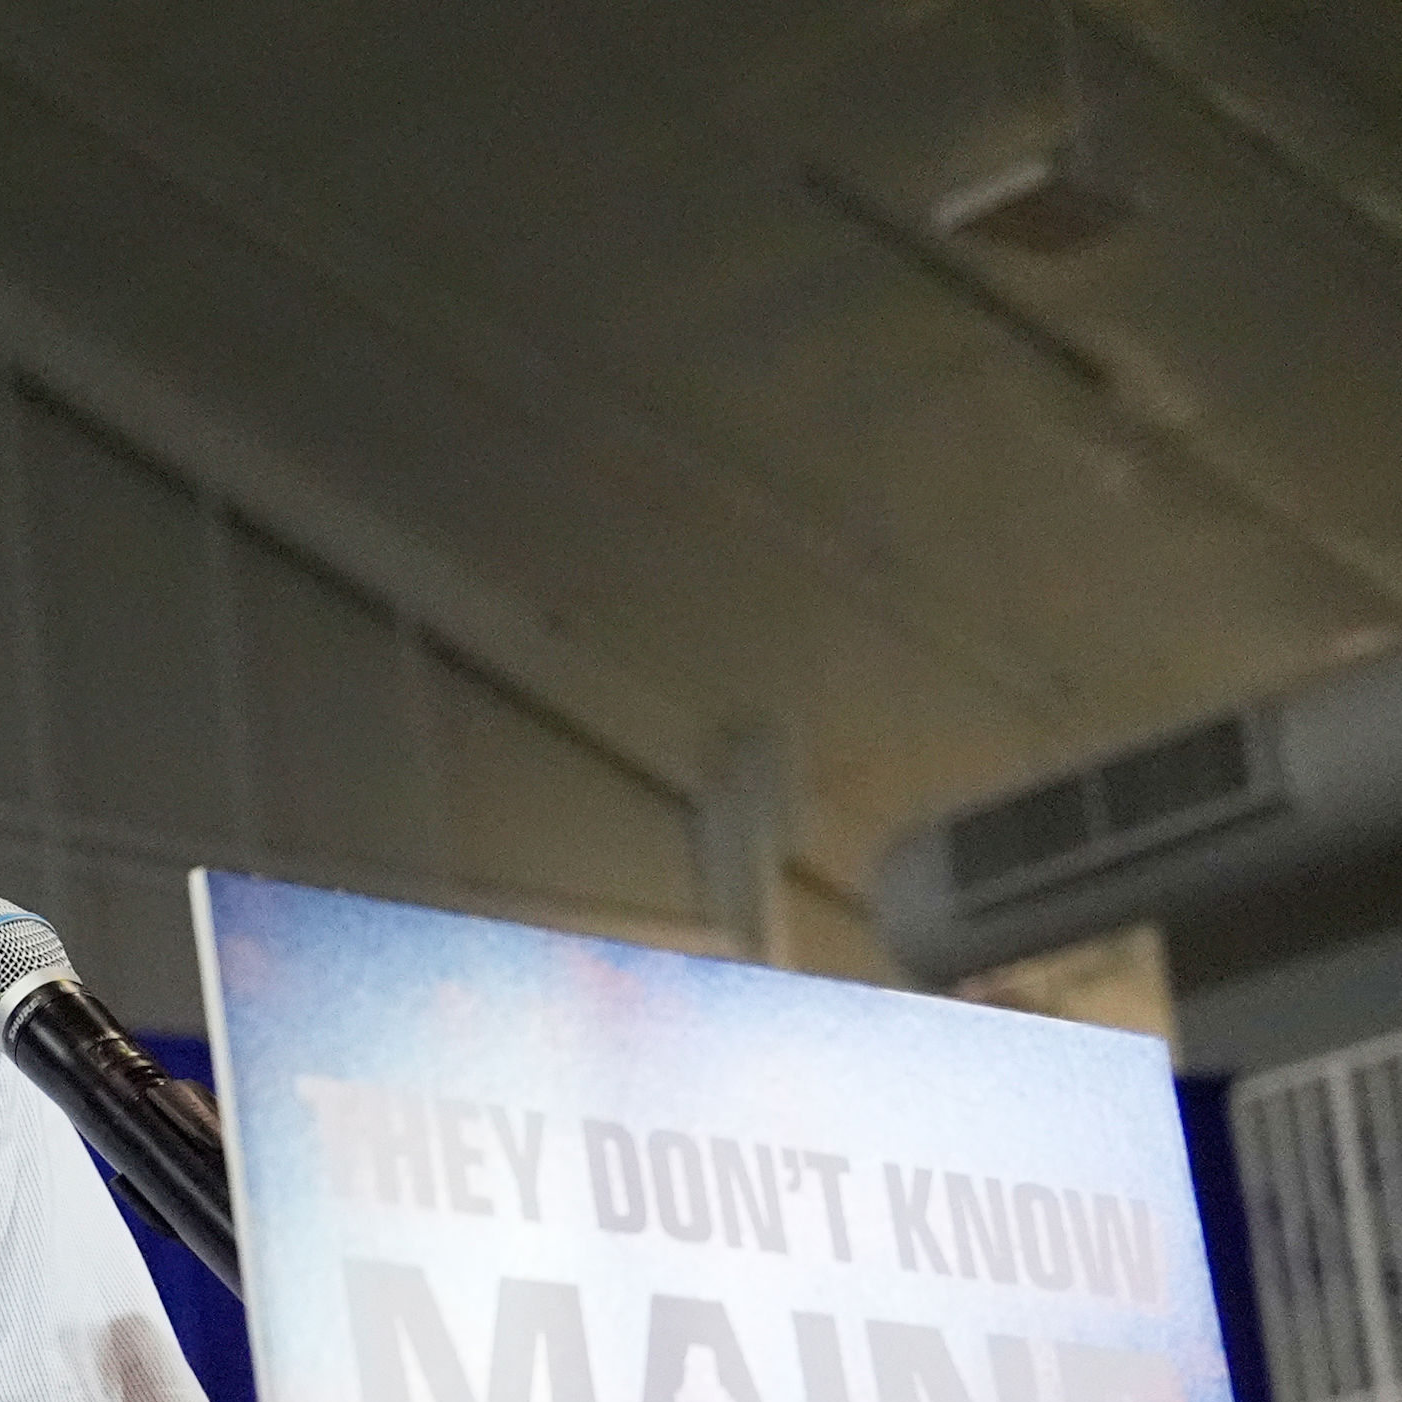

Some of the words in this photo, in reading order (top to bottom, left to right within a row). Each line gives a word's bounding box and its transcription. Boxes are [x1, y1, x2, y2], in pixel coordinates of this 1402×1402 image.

[299, 1075, 546, 1224] THEY
[583, 1118, 852, 1264] DON'T
[882, 1161, 1164, 1308] KNOW
